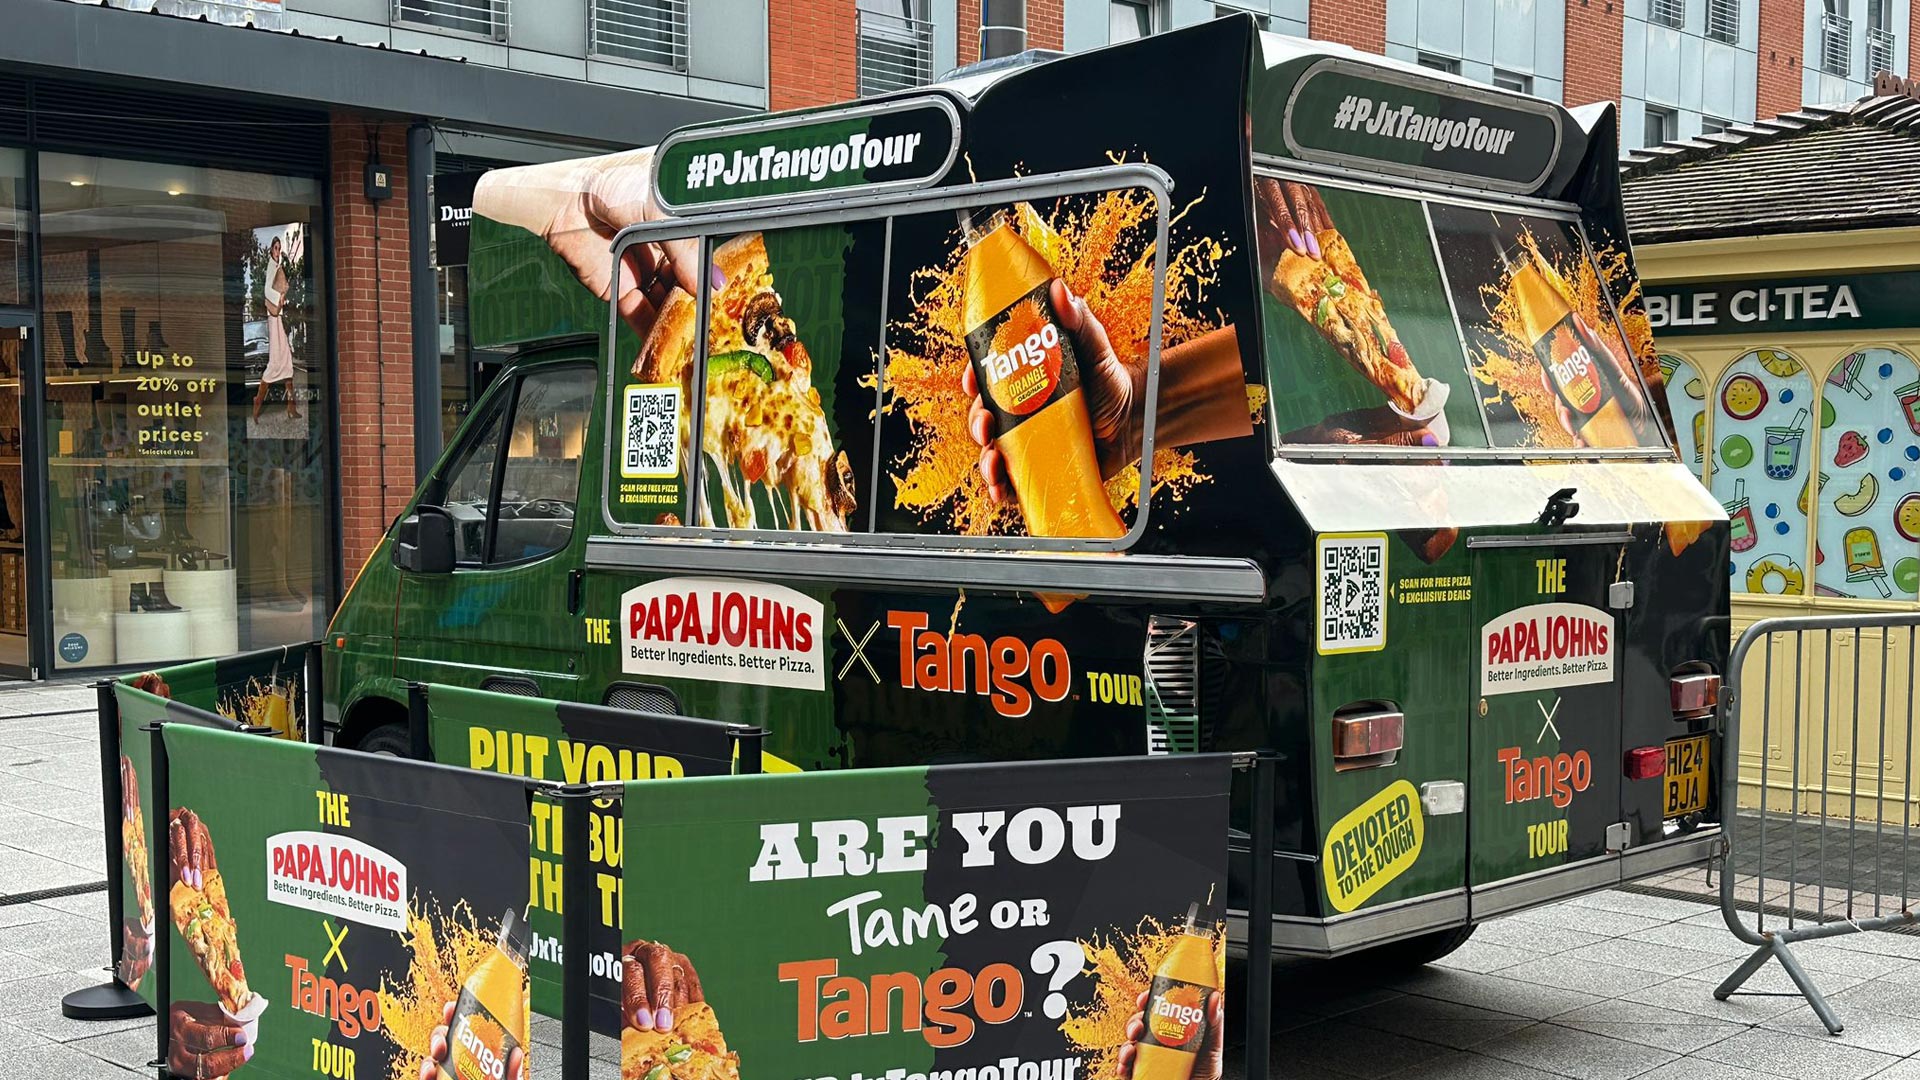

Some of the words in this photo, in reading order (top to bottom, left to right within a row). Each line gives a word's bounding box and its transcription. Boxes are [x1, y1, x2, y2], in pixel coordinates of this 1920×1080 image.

[1333, 95, 1516, 155] #PJxTangoTour
[686, 132, 921, 189] #PJxTangoTour
[136, 351, 164, 369] Up
[172, 353, 193, 367] to
[981, 323, 1058, 385] Tango
[1548, 345, 1591, 387] Tango
[137, 376, 179, 391] 20%
[187, 378, 216, 393] off
[1009, 364, 1047, 397] ORANGE
[137, 402, 202, 417] outlet
[620, 484, 635, 492] SCAN
[636, 484, 647, 492] FOR
[648, 484, 661, 492] FREE
[661, 484, 678, 493] PIZZA
[625, 494, 658, 503] EXCLUSIVE
[658, 494, 678, 504] DEALS
[1399, 578, 1419, 589] SCAN
[1420, 577, 1433, 588] FOR
[1435, 576, 1451, 588] FREE
[1451, 575, 1471, 587] PIZZA
[1535, 558, 1567, 594] THE
[1406, 590, 1447, 604] EXCLUSIVE
[1447, 589, 1471, 602] DEALS
[585, 618, 611, 644] THE
[630, 592, 705, 644] PAPA
[707, 591, 813, 653] JOHNS
[1489, 620, 1541, 665] PAPA
[1543, 615, 1608, 661] JOHNS
[631, 645, 665, 661] Better
[668, 648, 737, 667] Ingredients.
[739, 656, 776, 671] Better
[779, 656, 815, 674] Pizza.
[887, 610, 1072, 718] Tango
[1488, 667, 1513, 682] Better
[1514, 664, 1561, 681] Ingredients.
[1562, 662, 1586, 675] Better
[1586, 660, 1608, 673] Pizza.
[1087, 671, 1143, 707] TOUR
[1497, 747, 1591, 808] Tango
[1668, 776, 1699, 812] BJA
[316, 790, 351, 828] THE
[749, 814, 928, 882] ARE
[951, 804, 1121, 868] YOU
[1331, 794, 1410, 881] DEVOTED
[1527, 819, 1568, 859] TOUR
[273, 843, 327, 886] PAPA
[328, 846, 400, 902] JOHNS
[1338, 875, 1354, 899] TO
[1352, 854, 1376, 888] THE
[1374, 818, 1416, 871] DOUGH
[273, 879, 299, 895] Better
[299, 885, 347, 907] Ingredients.
[348, 896, 374, 913] Better
[374, 903, 401, 919] Pizza.
[826, 889, 979, 956] Tame
[990, 899, 1050, 929] OR
[285, 953, 381, 1039] Tango
[778, 957, 1024, 1048] Tango
[1154, 995, 1204, 1026] Tango
[312, 1037, 356, 1080] TOUR
[459, 1013, 504, 1079] Tango
